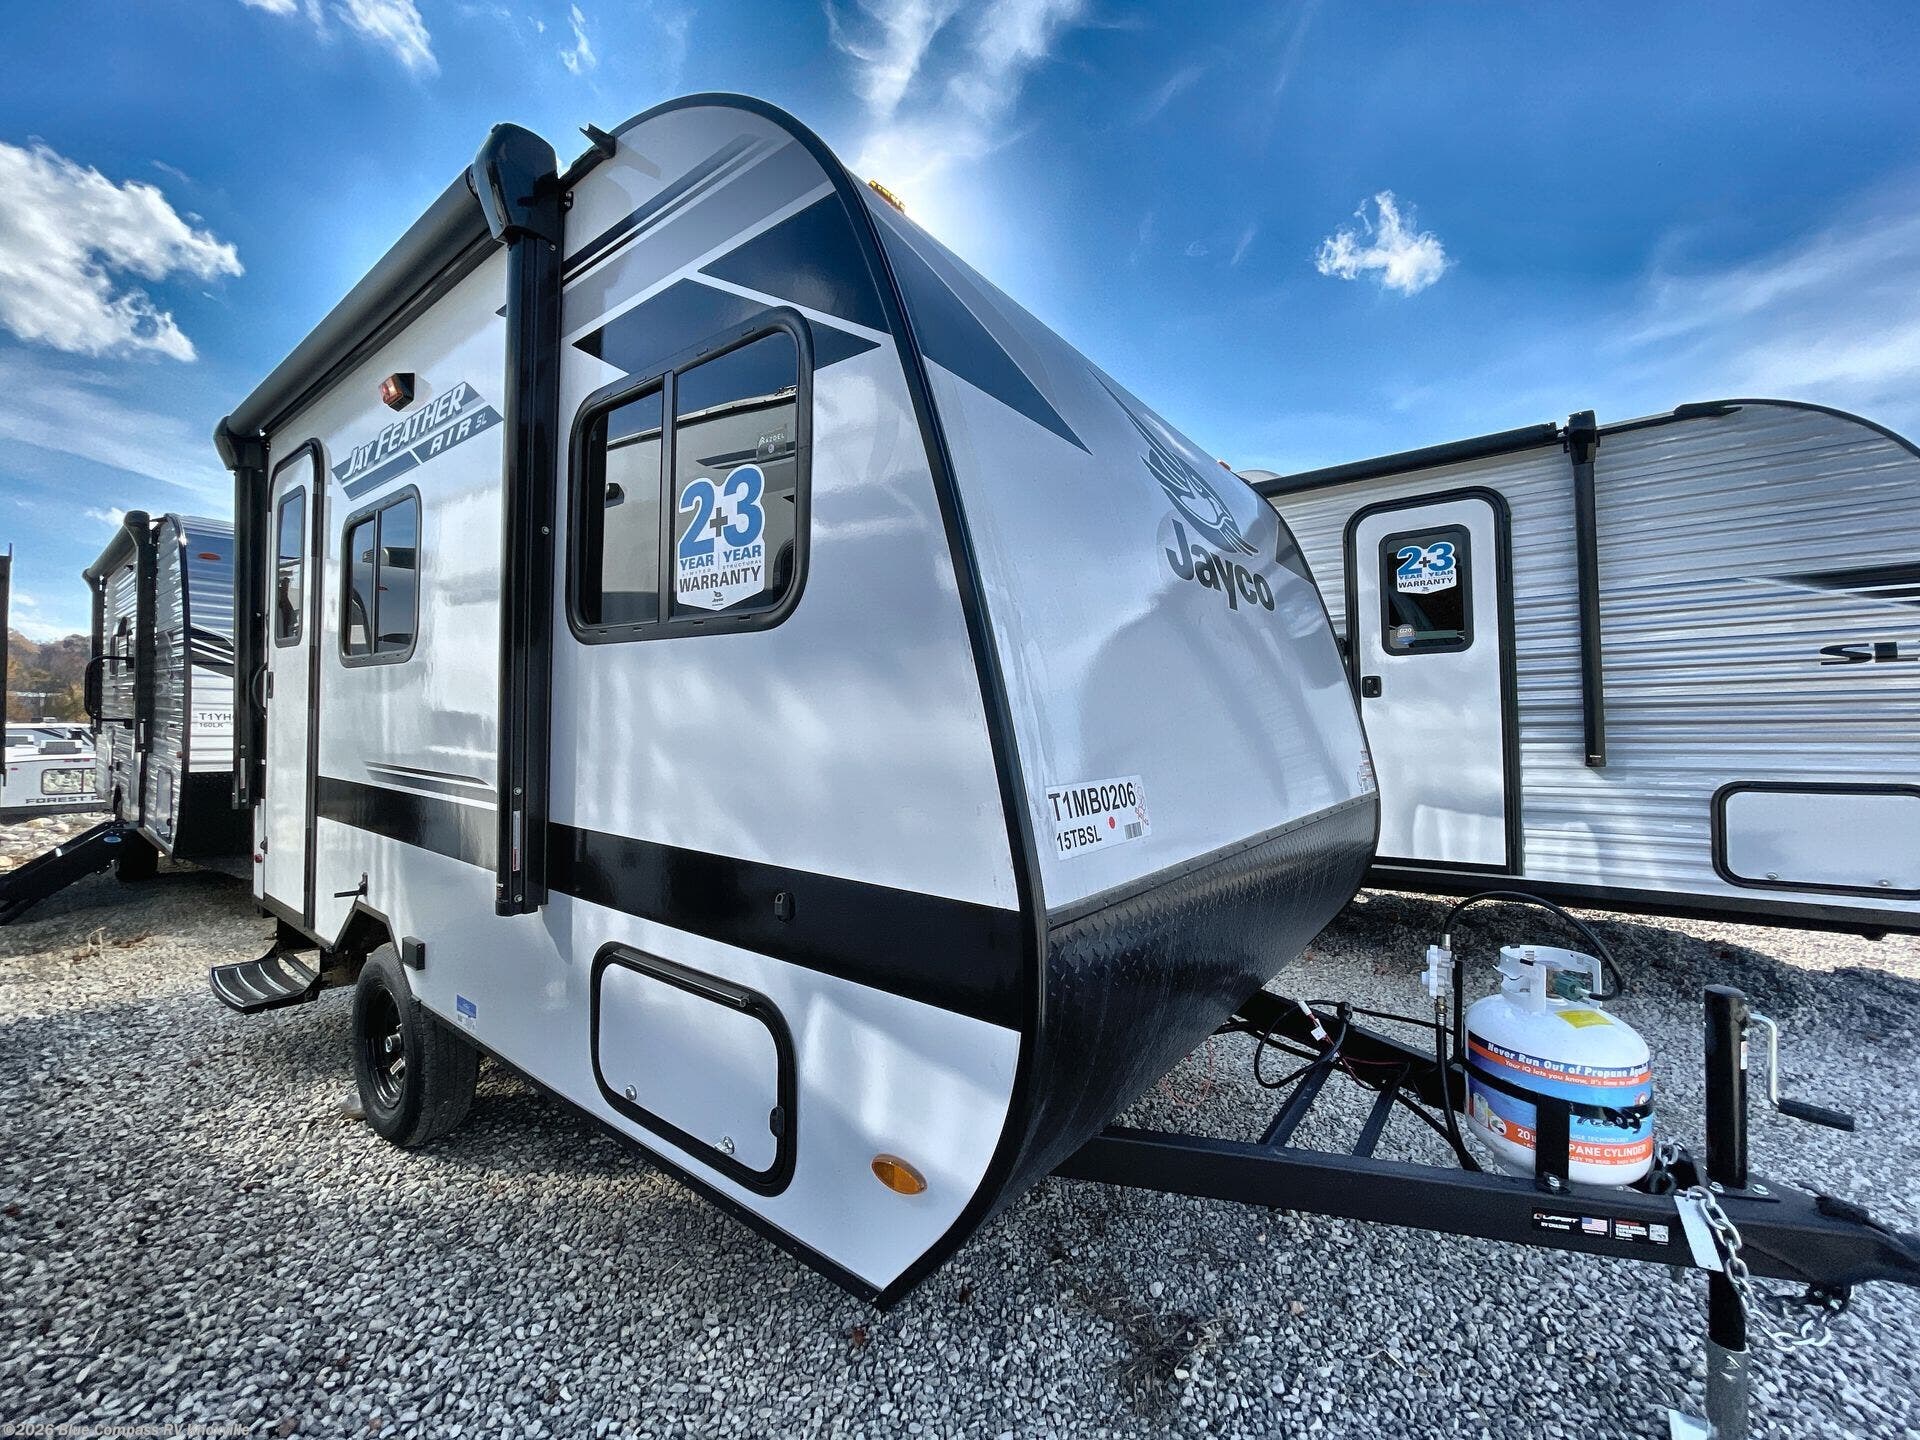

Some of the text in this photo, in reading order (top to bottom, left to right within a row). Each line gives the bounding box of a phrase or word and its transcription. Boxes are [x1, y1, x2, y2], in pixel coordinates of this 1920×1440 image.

[342, 382, 466, 479] JAY FEATHER
[429, 410, 487, 455] AIR SL
[680, 545, 762, 571] YEAR YEAR
[1165, 518, 1275, 611] Jayco
[680, 565, 762, 593] WARRANTY
[1399, 577, 1453, 589] WARRANTY
[1428, 569, 1454, 577] YEAR
[1820, 641, 1919, 666] SL
[198, 712, 232, 721] T1YH
[26, 796, 87, 804] FOREST
[1048, 782, 1136, 821] T1MB0206
[1056, 825, 1102, 852] 15TBSL
[1488, 1042, 1515, 1059] Never
[1519, 1053, 1539, 1067] Run
[1544, 1060, 1564, 1073] Out
[1568, 1065, 1581, 1075] of
[1585, 1067, 1627, 1079] Propane
[1505, 1060, 1520, 1069] Your
[1533, 1069, 1546, 1077] lets
[1548, 1072, 1563, 1080] you
[1517, 1128, 1530, 1140] 20
[1569, 1143, 1601, 1157] PANE
[1603, 1144, 1647, 1157] CYLINDER
